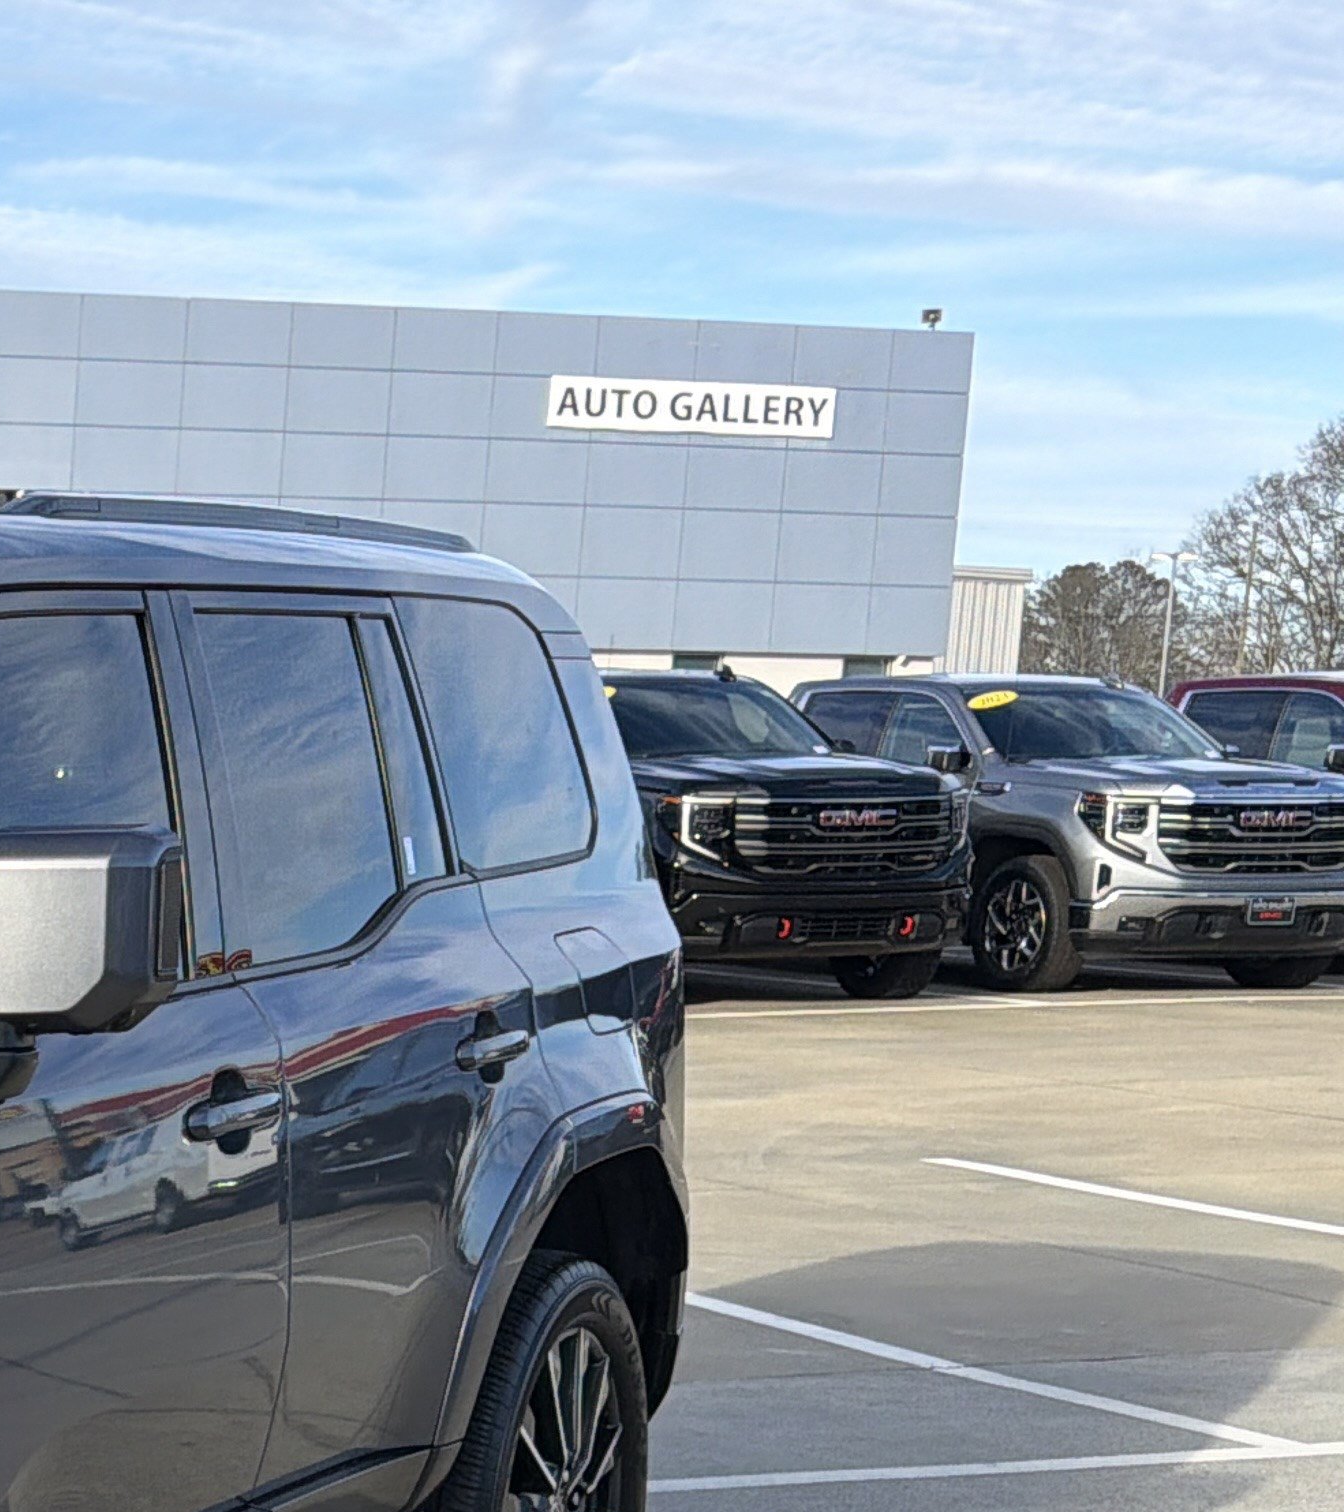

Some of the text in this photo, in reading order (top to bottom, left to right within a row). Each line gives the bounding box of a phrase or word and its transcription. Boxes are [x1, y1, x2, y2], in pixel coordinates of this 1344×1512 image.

[556, 386, 829, 428] AUTO GALLERY
[819, 809, 897, 827] GMC
[1240, 810, 1312, 828] GMC
